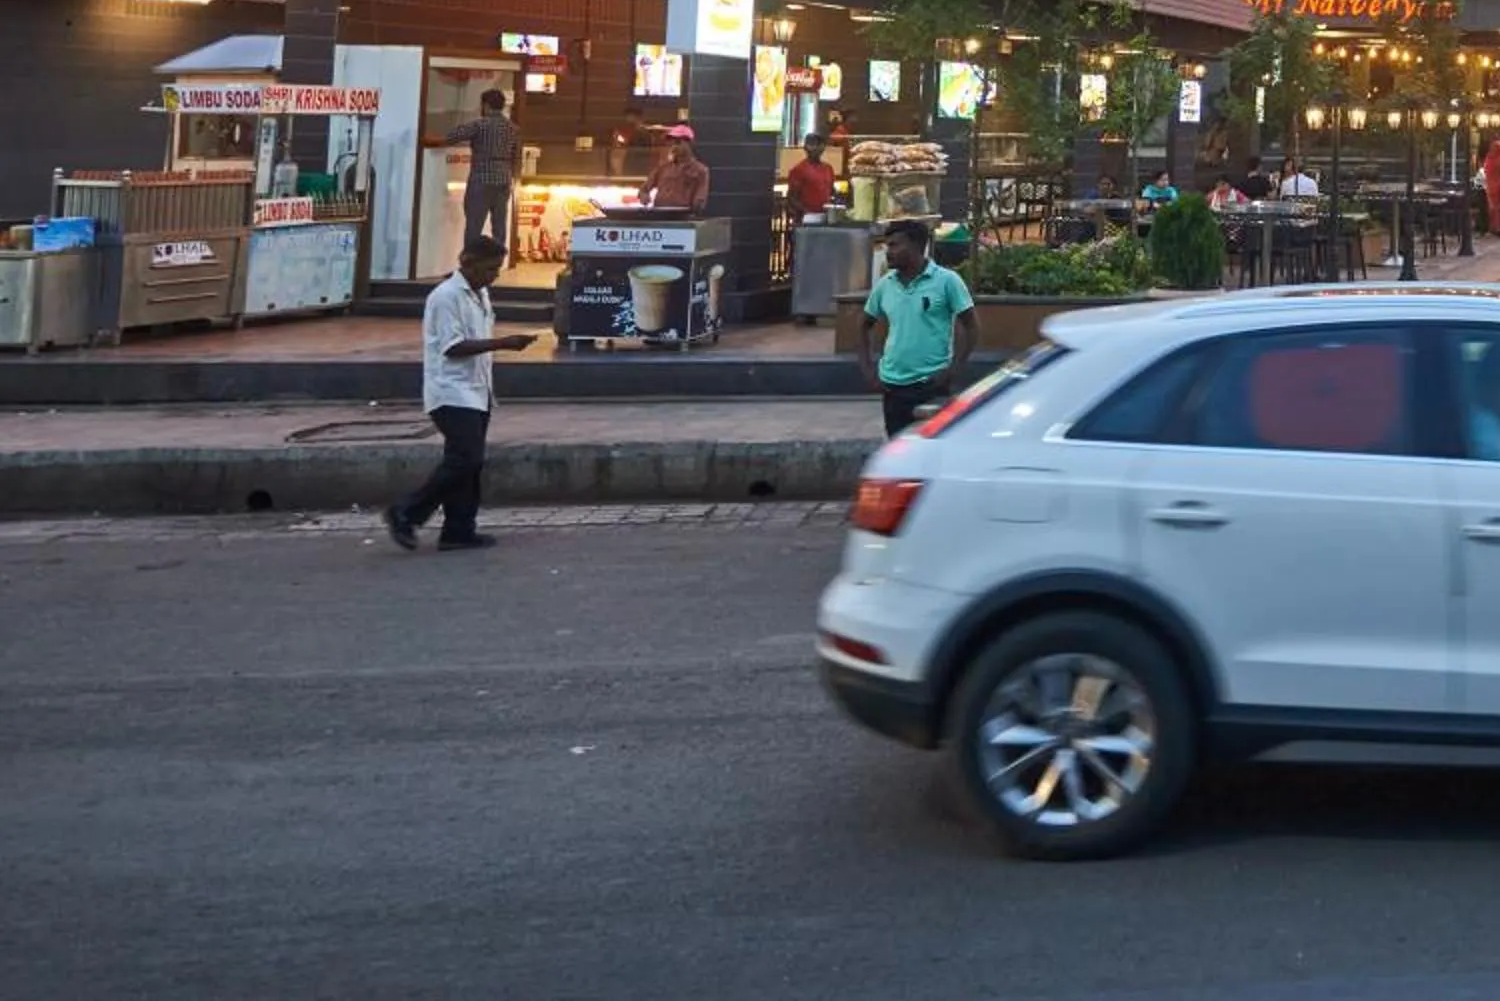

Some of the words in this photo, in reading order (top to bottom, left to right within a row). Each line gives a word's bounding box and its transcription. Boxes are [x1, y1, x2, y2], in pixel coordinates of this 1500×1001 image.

[181, 90, 223, 108] LIMBU
[227, 90, 261, 108] SODA
[295, 88, 345, 110] KRISHNA
[350, 88, 379, 111] SODA
